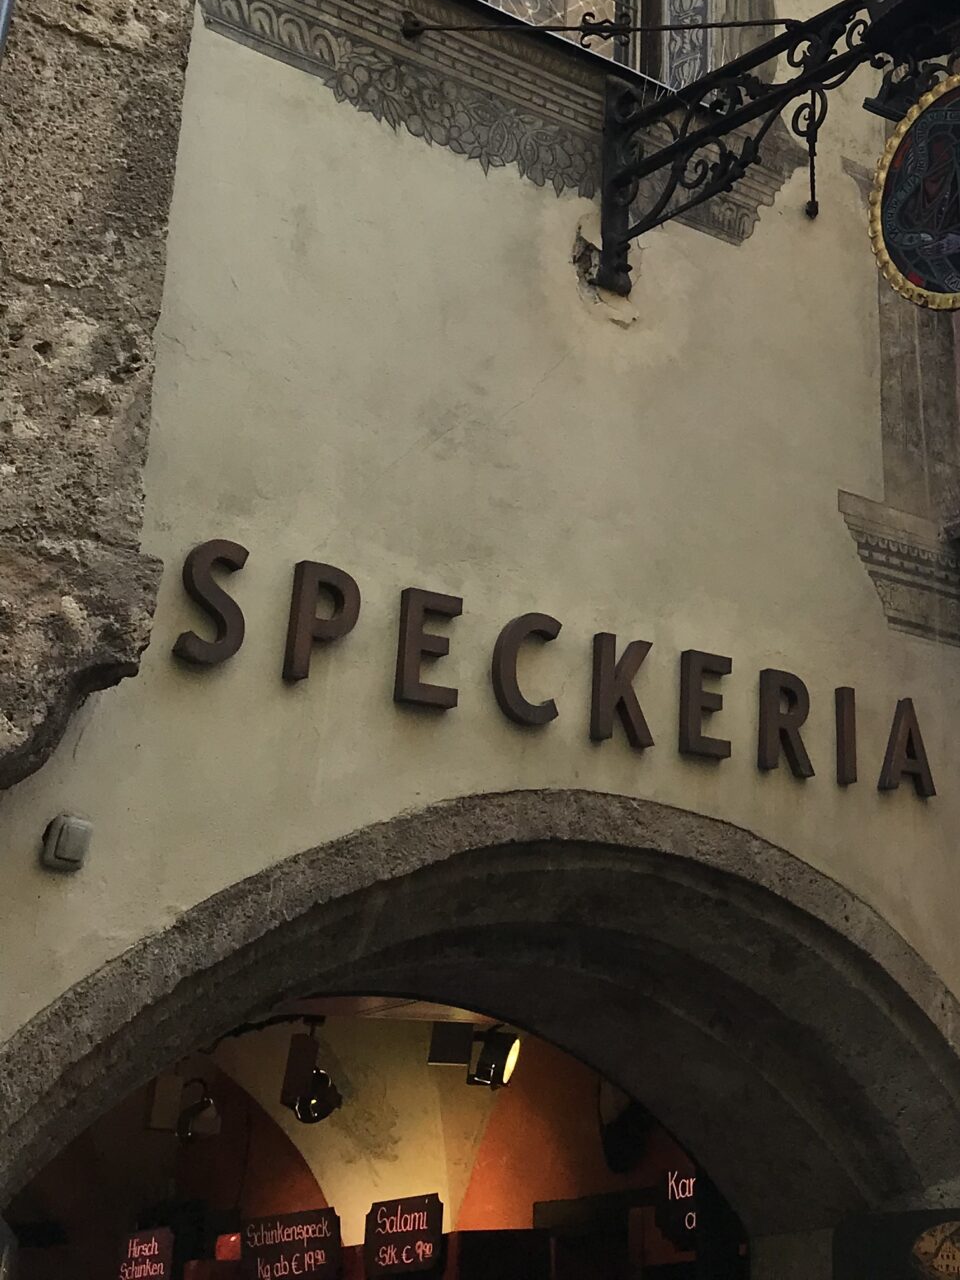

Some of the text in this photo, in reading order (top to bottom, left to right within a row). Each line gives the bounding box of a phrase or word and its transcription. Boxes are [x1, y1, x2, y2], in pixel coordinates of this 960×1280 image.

[171, 538, 937, 799] SPECKERIA
[246, 1216, 332, 1249] Schinkenspeck
[375, 1204, 428, 1234] Salami
[127, 1236, 159, 1259] Hirsch
[273, 1254, 290, 1278] ab
[291, 1253, 303, 1275] €
